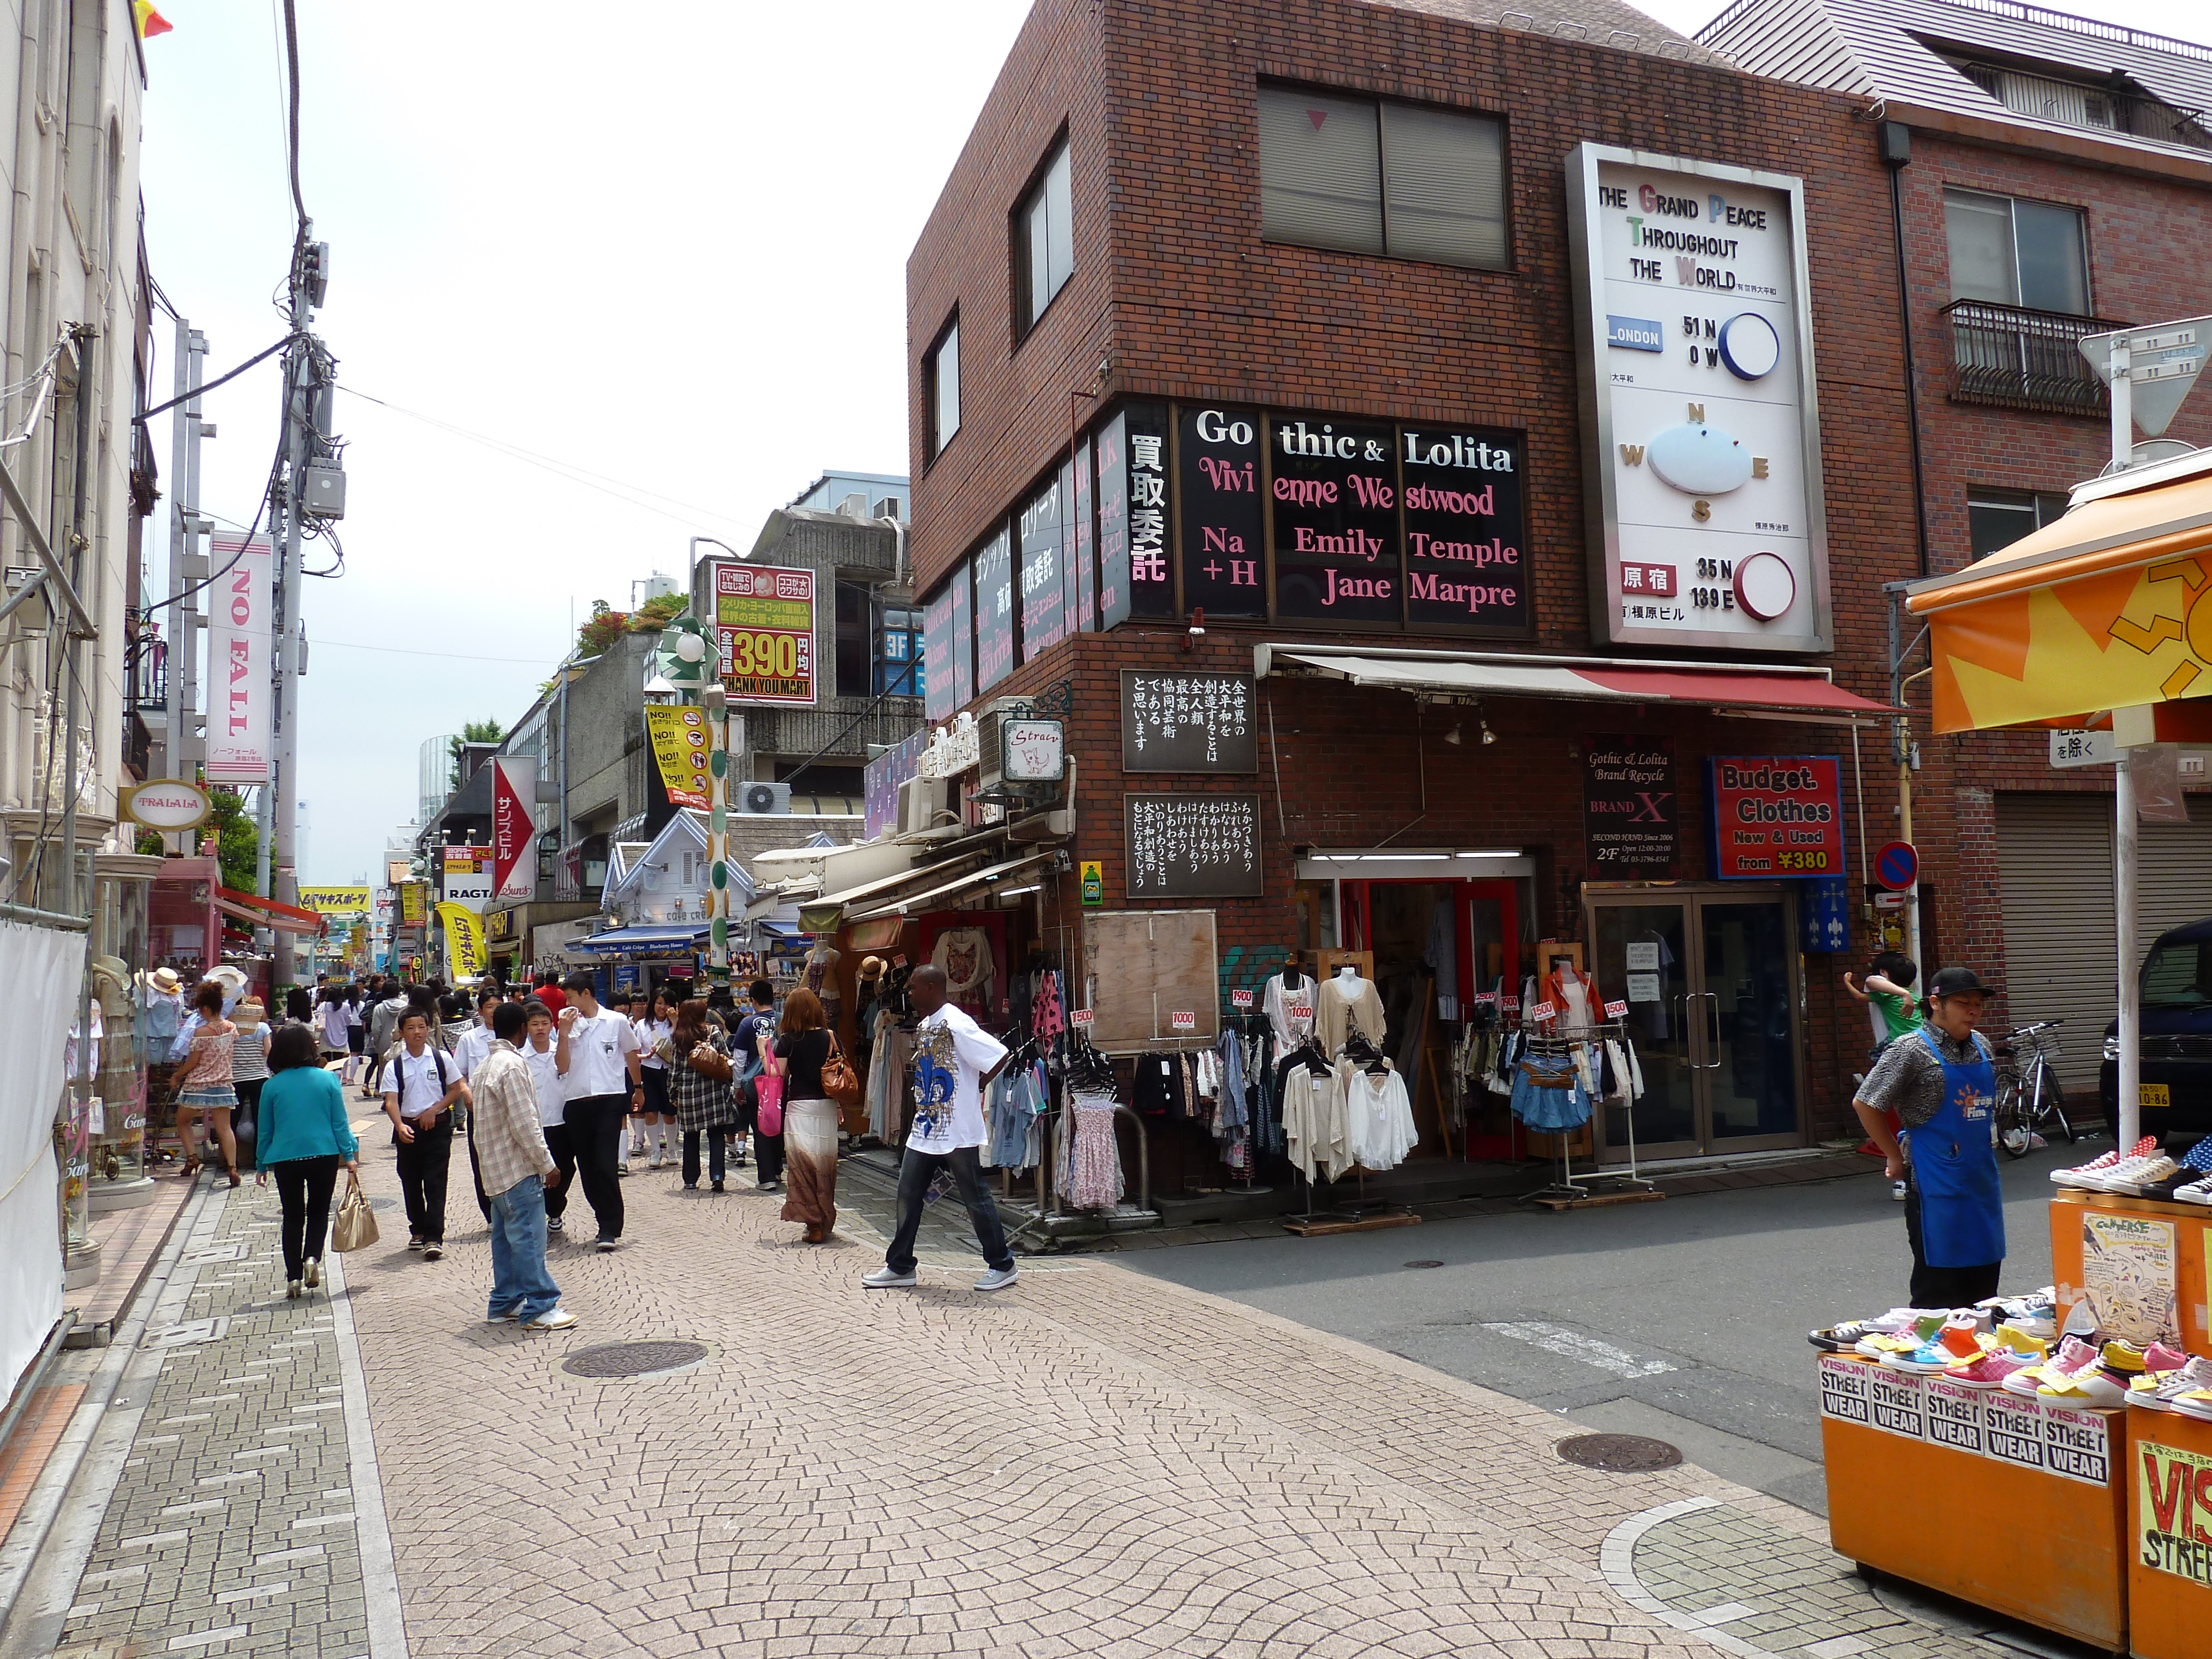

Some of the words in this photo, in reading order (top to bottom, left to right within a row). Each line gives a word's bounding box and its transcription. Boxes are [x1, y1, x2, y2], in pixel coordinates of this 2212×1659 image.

[1599, 186, 1628, 208] THE
[1639, 184, 1698, 218] GRAND
[1709, 194, 1766, 230] PEACE
[1627, 216, 1738, 259] THROUGHOUT
[1630, 258, 1662, 280] THE
[1676, 255, 1736, 290] WORLD
[1606, 319, 1659, 346] LONDON
[1687, 402, 1705, 424] N
[1364, 440, 1385, 461] &
[1404, 433, 1514, 473] Lolita
[1619, 444, 1645, 466] W
[1752, 457, 1769, 478] E
[1131, 435, 1166, 581] 買取委託
[1692, 500, 1711, 521] S
[1294, 527, 1384, 563] Emily
[1409, 532, 1519, 569] Temple
[721, 581, 750, 591] おなじみの
[1321, 568, 1391, 606] Jane
[1409, 572, 1516, 613] Marpre
[1624, 567, 1667, 590] 原宿
[231, 567, 251, 626] NO
[721, 631, 733, 674] 全商品
[733, 632, 796, 677] 390
[797, 638, 809, 677] 円均一
[886, 635, 907, 658] 3F
[229, 638, 248, 737] FALL
[759, 678, 779, 694] YOU
[780, 680, 809, 695] MART
[1133, 677, 1147, 751] と思います
[1148, 680, 1161, 725] である
[1161, 679, 1176, 738] 協同芸術
[1176, 679, 1189, 724] 最高の
[1189, 678, 1204, 725] 全人類
[1218, 680, 1232, 737] 大平和を
[1232, 680, 1246, 736] 全世界の
[1204, 680, 1219, 762] 創造することは
[654, 731, 675, 740] NO!!
[1011, 730, 1058, 745] Straw
[2057, 737, 2093, 758] を除く
[659, 752, 679, 761] NO!!
[1589, 752, 1622, 768] Gothic
[1625, 752, 1636, 765] &
[1637, 753, 1668, 765] Lolita
[1595, 768, 1628, 781] Brand
[1629, 769, 1664, 784] Recycle
[1590, 801, 1635, 812] BRAND
[1627, 792, 1673, 822] X
[1737, 797, 1832, 823] Clothes
[498, 797, 513, 860] サンズビル
[1166, 802, 1177, 862] しあわせを
[1177, 802, 1187, 854] わけあう
[1198, 802, 1209, 864] たすけあう
[1209, 802, 1220, 864] わかりあう
[1220, 802, 1231, 863] はなしあう
[1230, 802, 1241, 853] ふれあう
[1734, 830, 1765, 845] New
[1772, 830, 1785, 844] &
[1789, 830, 1824, 844] Used
[1597, 848, 1619, 860] 2F
[1622, 845, 1637, 853] Open
[1737, 855, 1771, 870] from
[1777, 851, 1828, 869] ¥380
[1173, 1013, 1193, 1023] 1000
[1292, 1007, 1312, 1018] 1000
[1532, 1003, 1552, 1015] 1500
[1606, 1001, 1625, 1014] 1500
[1821, 1359, 1865, 1376] VISION
[1872, 1370, 1919, 1389] VISION
[1822, 1371, 1866, 1396] STREET
[1873, 1383, 1920, 1410] STREET
[1927, 1381, 1978, 1401] VISION
[1825, 1392, 1865, 1420] WEAR
[1928, 1395, 1978, 1423] STREET
[1985, 1394, 2040, 1415] VISION
[2046, 1406, 2104, 1430] VISION
[1877, 1405, 1919, 1433] WEAR
[1933, 1418, 1978, 1448] WEAR
[1986, 1408, 2041, 1437] STREET
[1991, 1433, 2039, 1463] WEAR
[2047, 1421, 2105, 1453] STREET
[2051, 1447, 2103, 1479] WEAR
